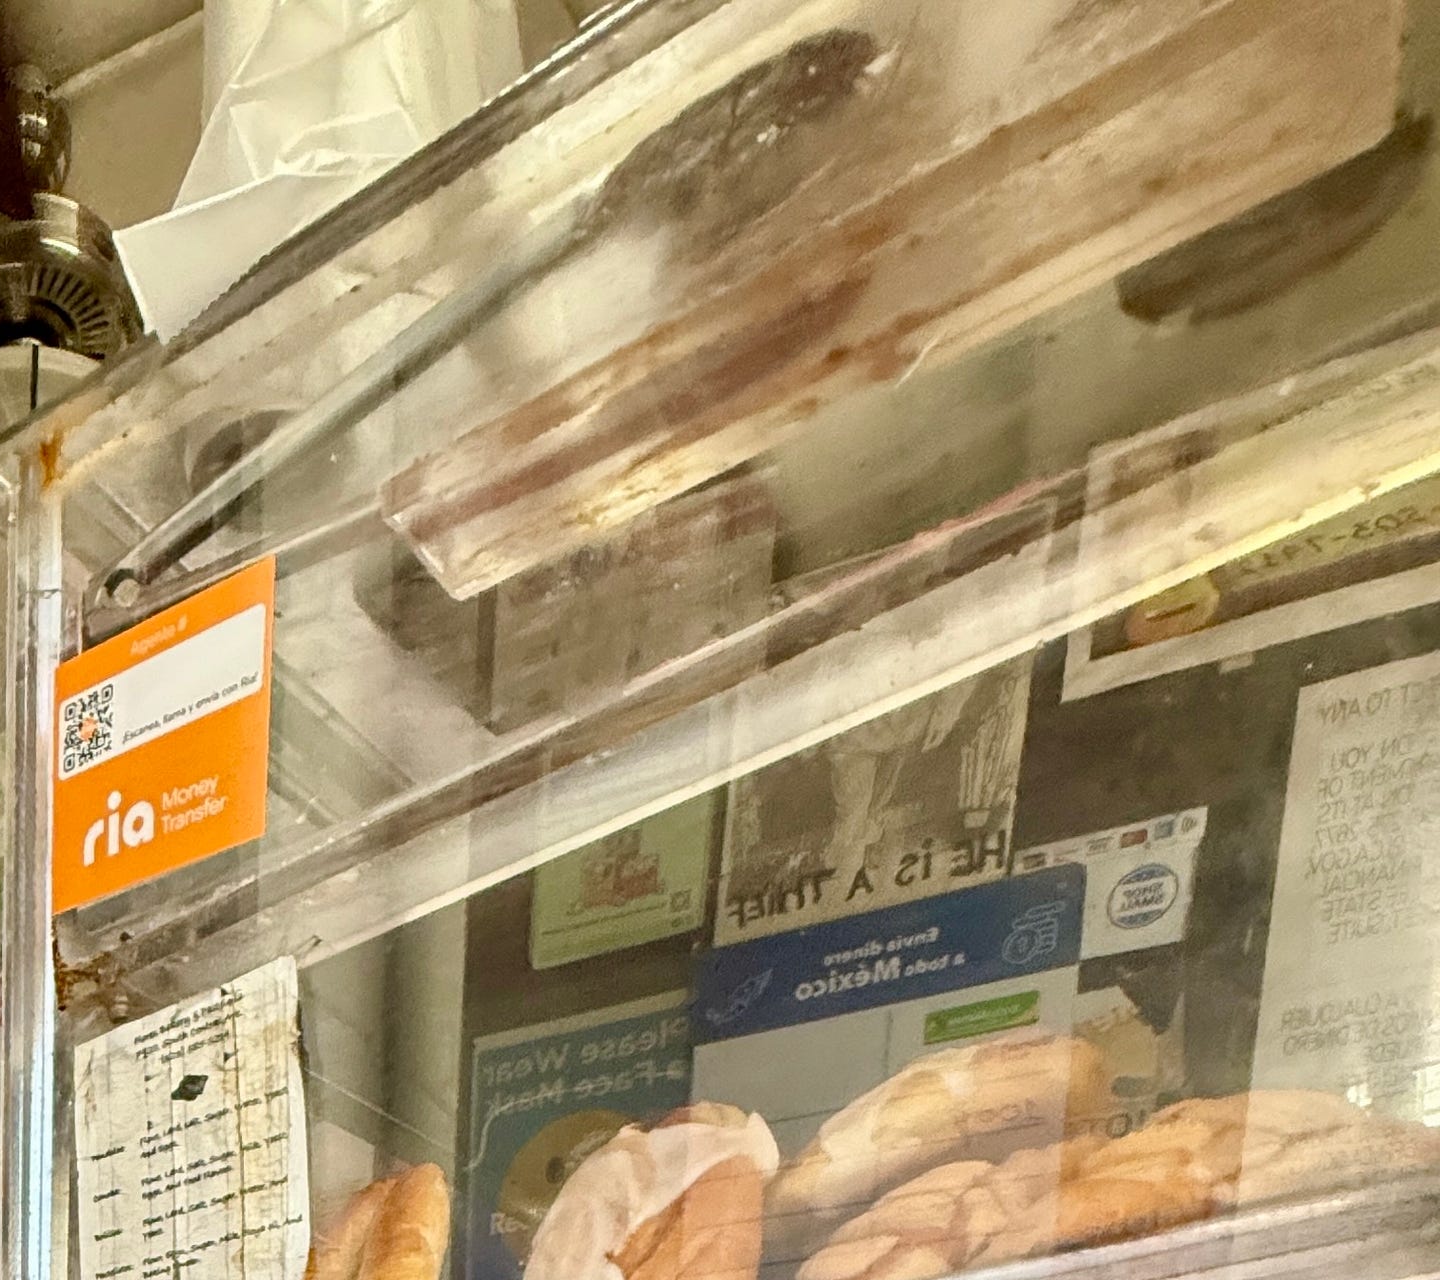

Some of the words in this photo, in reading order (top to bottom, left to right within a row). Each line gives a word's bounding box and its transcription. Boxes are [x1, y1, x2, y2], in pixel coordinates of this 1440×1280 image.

[162, 775, 219, 810] Money
[82, 790, 156, 868] ria
[162, 795, 227, 834] Transfer
